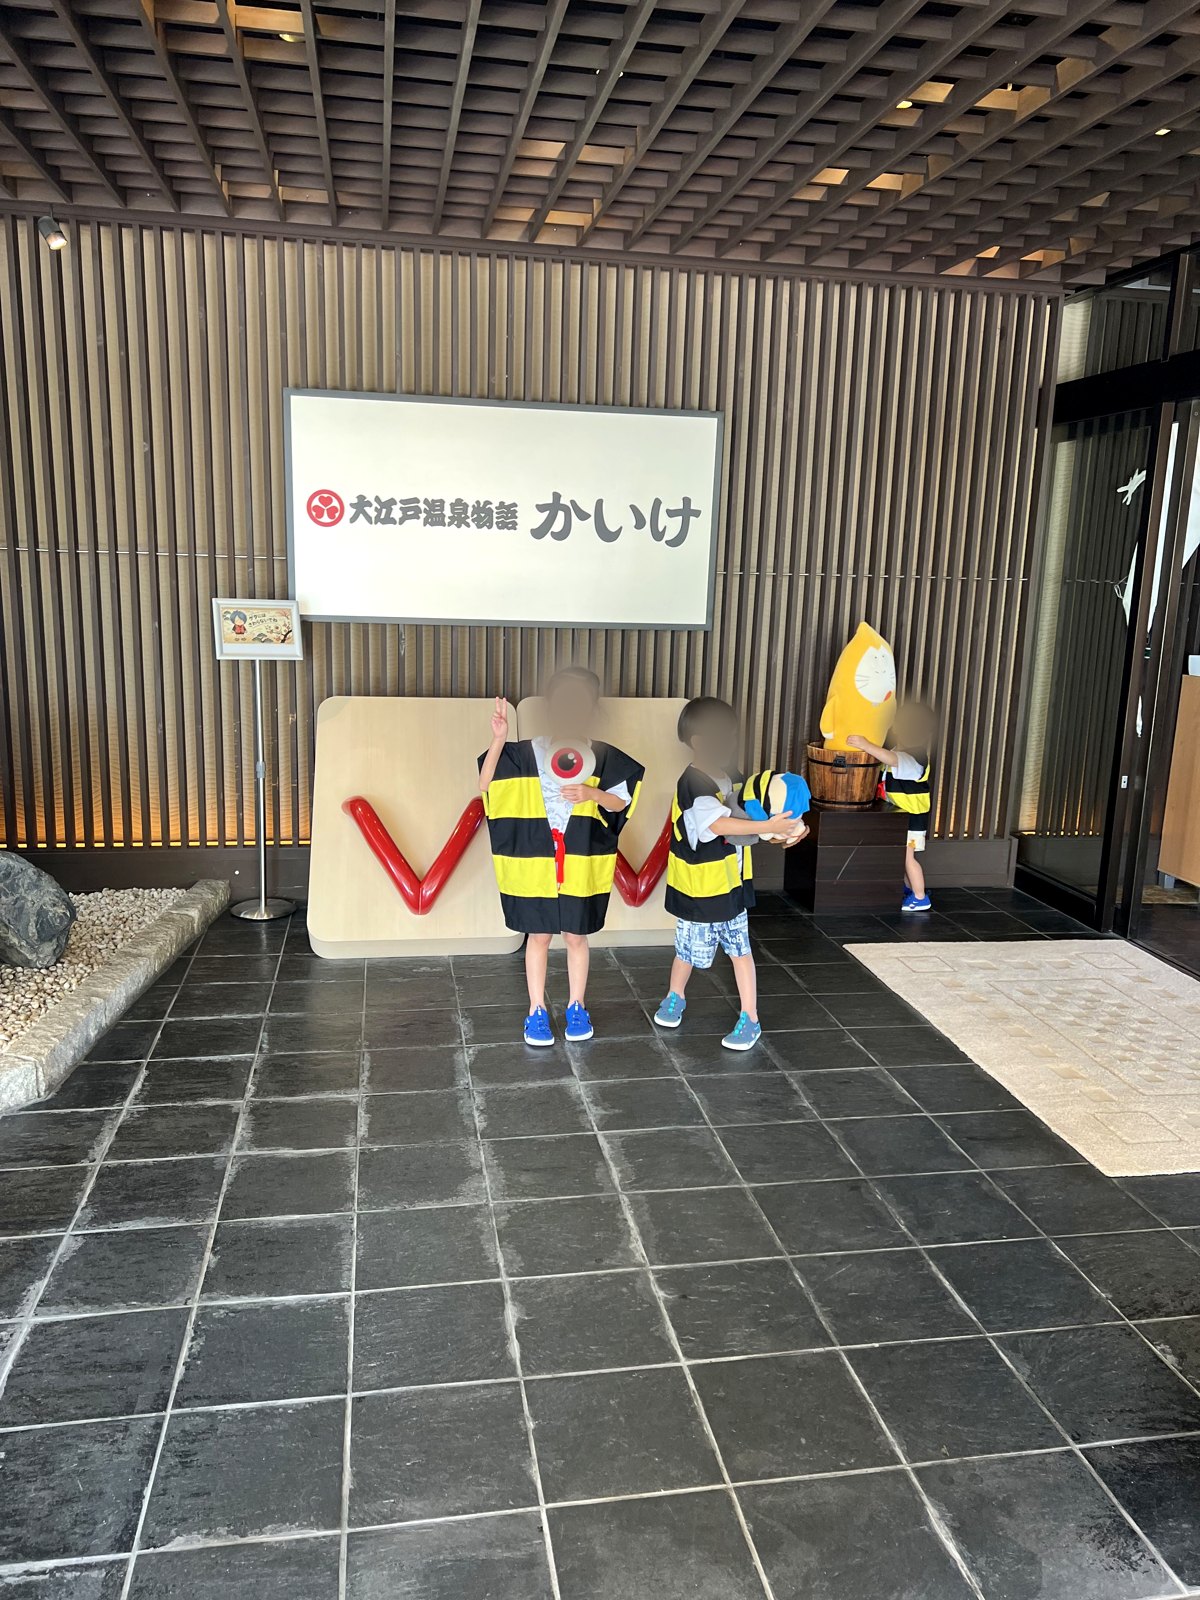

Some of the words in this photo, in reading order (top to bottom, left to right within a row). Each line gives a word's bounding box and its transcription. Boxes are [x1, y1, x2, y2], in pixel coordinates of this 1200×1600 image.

[349, 494, 518, 531] 大江戸温泉物語
[530, 491, 701, 548] かいけ
